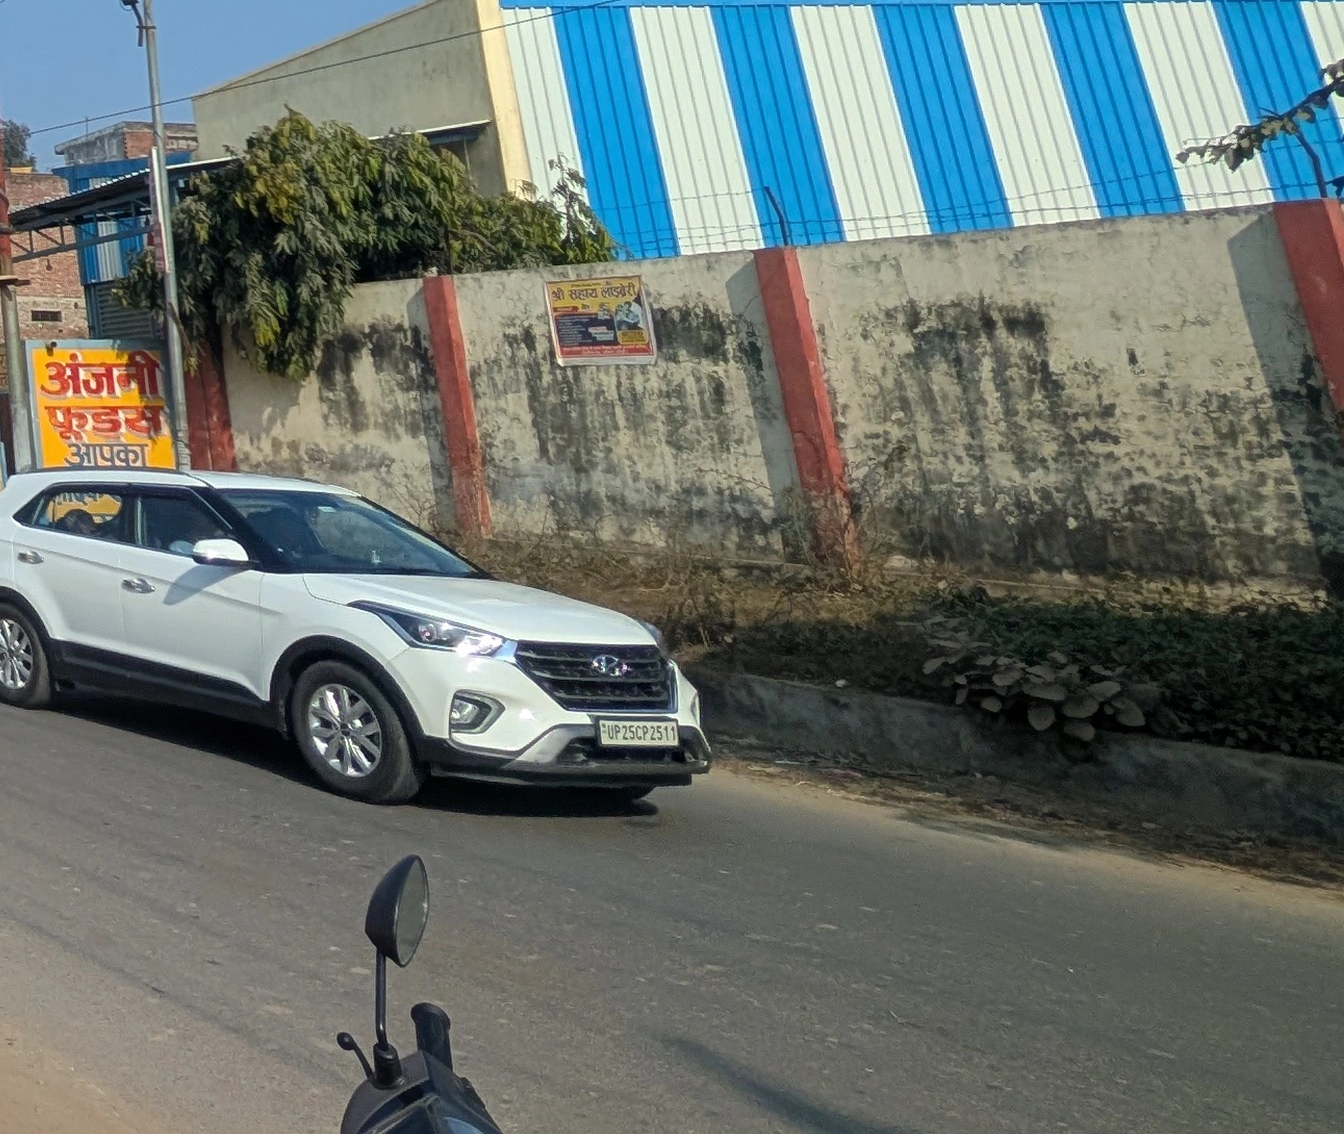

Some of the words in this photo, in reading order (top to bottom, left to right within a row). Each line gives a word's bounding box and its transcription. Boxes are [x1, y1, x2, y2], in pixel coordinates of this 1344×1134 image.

[552, 288, 565, 301] श्री
[40, 350, 160, 398] अंजनी
[64, 444, 149, 467] आपका
[607, 724, 676, 741] UP25CP2511
